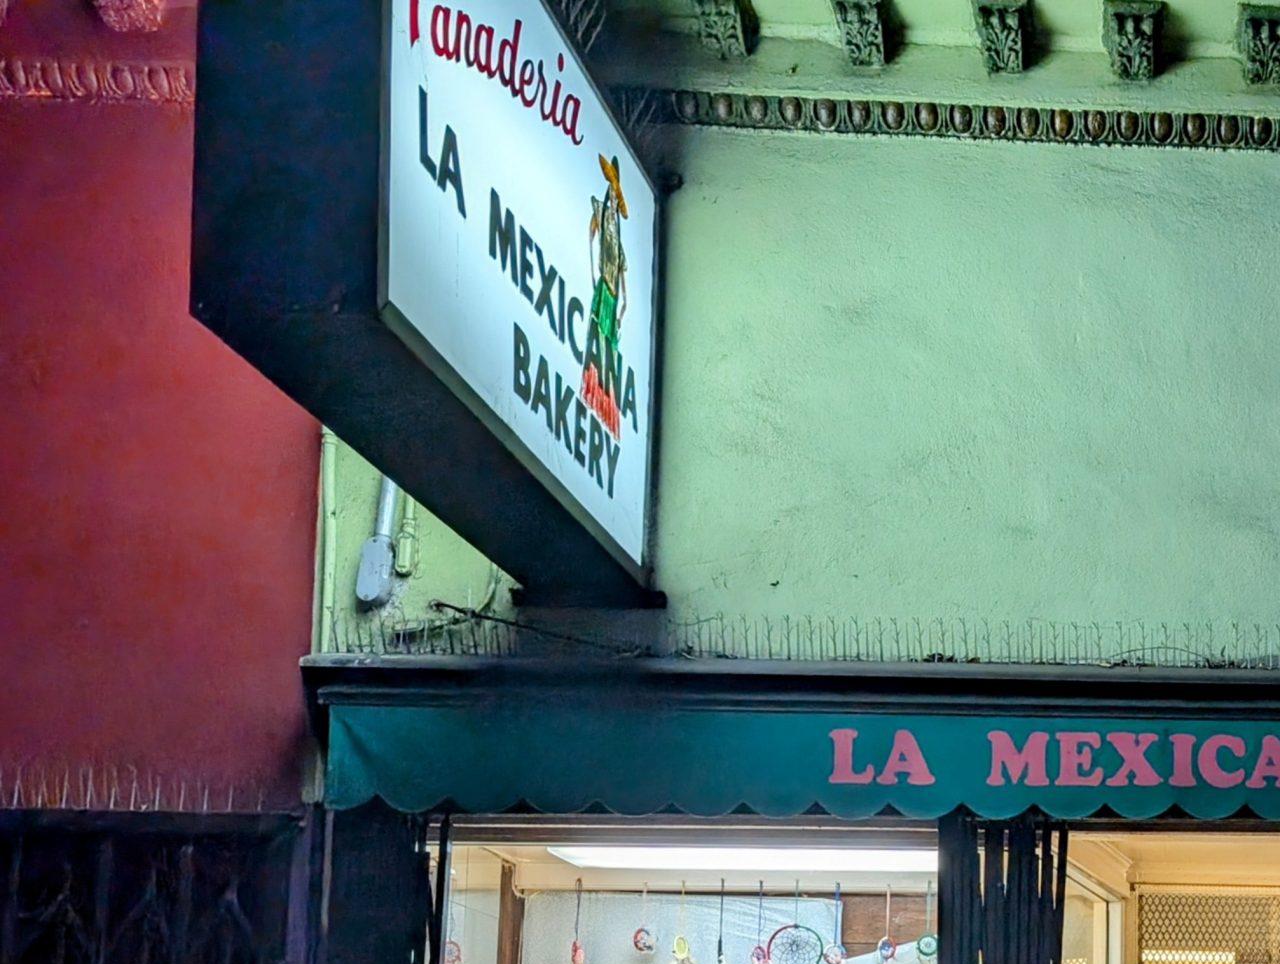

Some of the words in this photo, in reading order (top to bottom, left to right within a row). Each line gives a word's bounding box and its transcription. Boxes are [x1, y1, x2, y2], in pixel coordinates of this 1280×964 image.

[419, 84, 466, 219] LA
[489, 187, 638, 434] MEXICANA
[513, 321, 620, 499] BAKERY
[828, 728, 935, 785] LA
